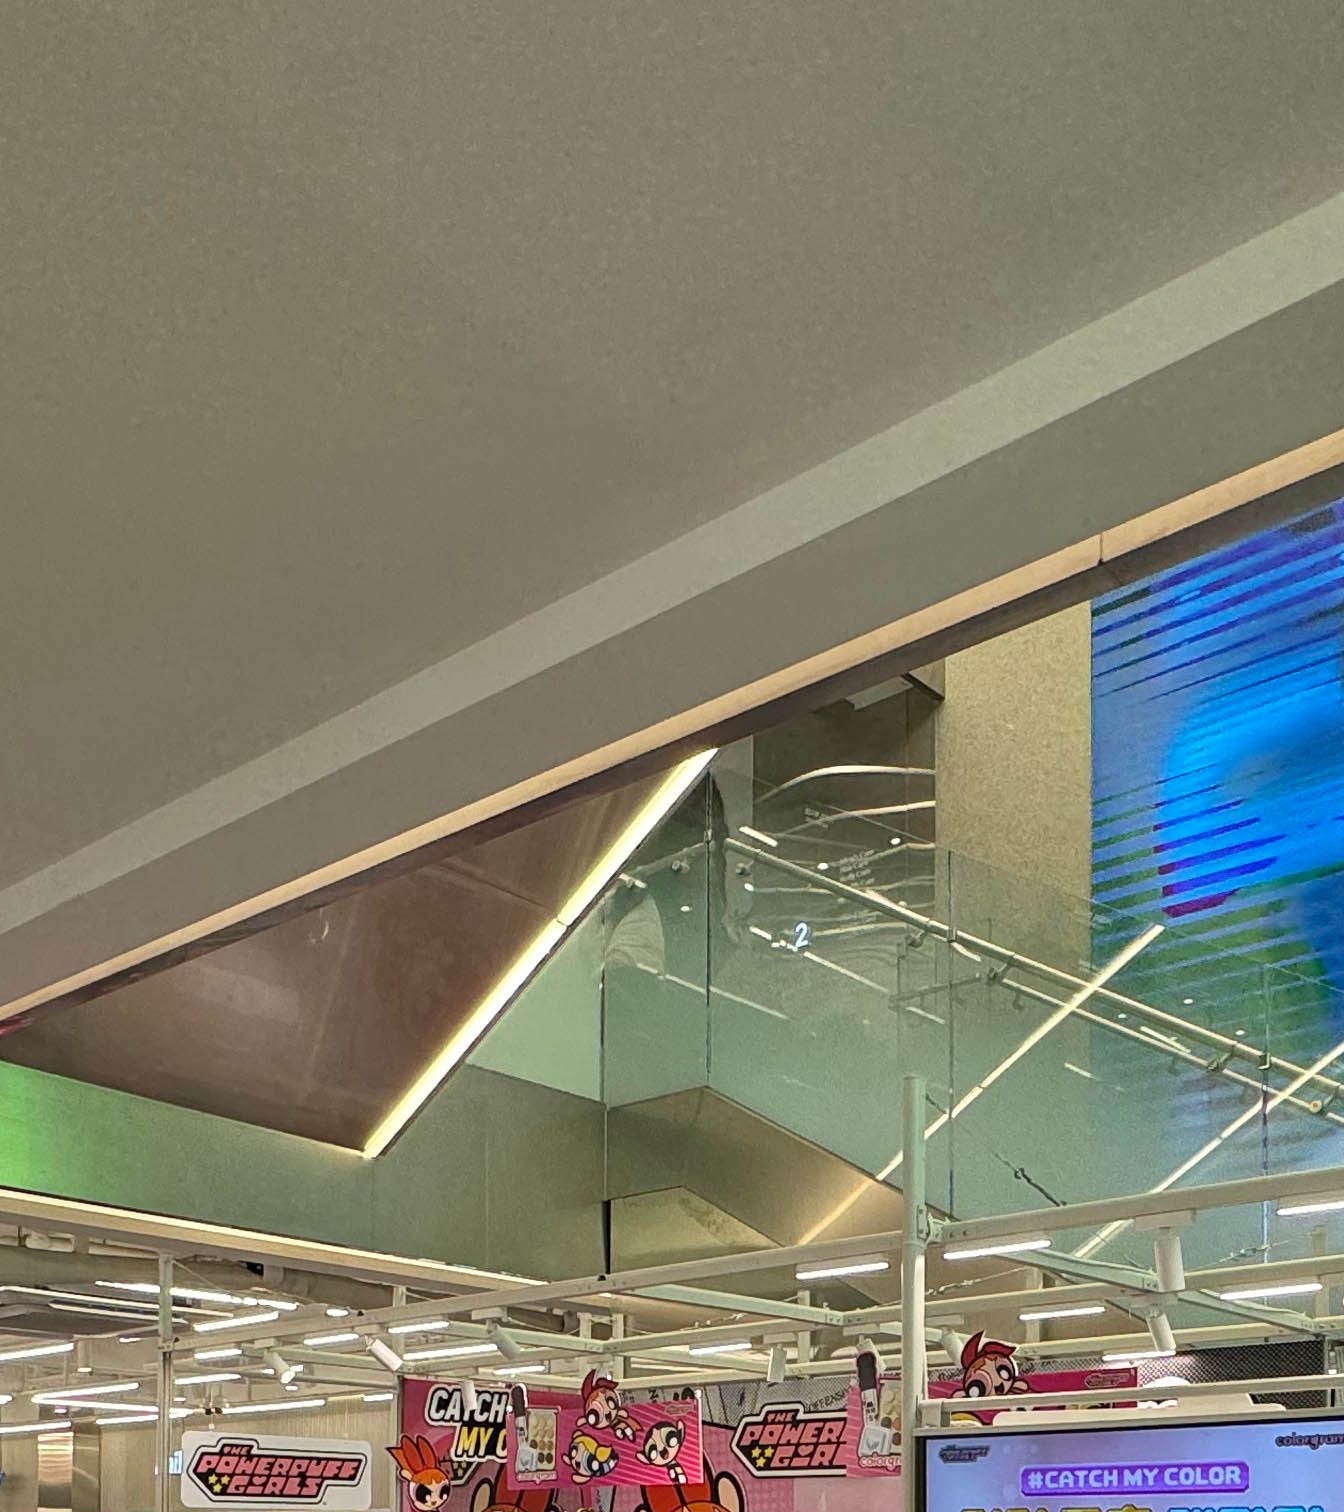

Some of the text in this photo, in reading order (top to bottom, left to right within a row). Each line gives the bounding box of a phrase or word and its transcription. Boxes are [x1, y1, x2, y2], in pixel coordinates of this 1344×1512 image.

[766, 1411, 794, 1422] THE
[457, 1426, 493, 1458] MY
[742, 1420, 847, 1445] POWER
[223, 1446, 252, 1455] THE
[197, 1455, 361, 1478] POWERPUFF
[1027, 1466, 1242, 1489] #CATCH MY COLOR
[227, 1475, 323, 1496] GIRLS
